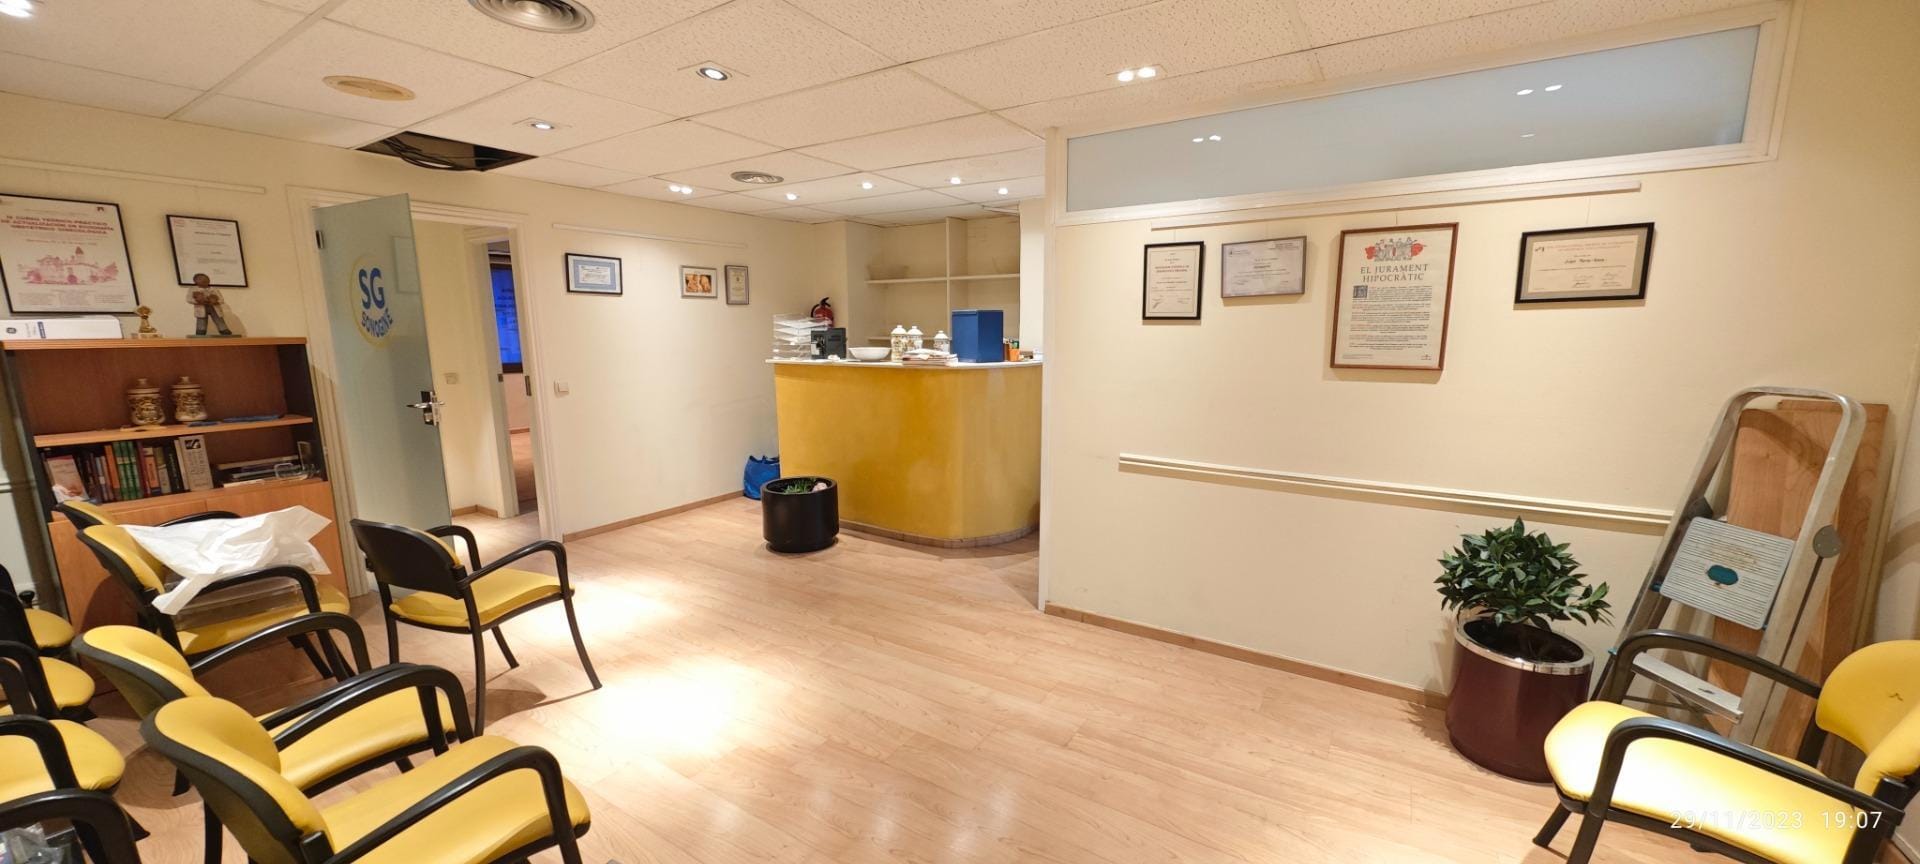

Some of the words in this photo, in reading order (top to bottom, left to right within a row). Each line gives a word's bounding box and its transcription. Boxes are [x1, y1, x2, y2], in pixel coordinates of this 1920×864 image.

[1360, 266, 1372, 275] EL
[1375, 264, 1429, 274] JURAMENT
[1362, 273, 1425, 283] HIPOCRÀTIC
[358, 267, 385, 310] SG
[361, 307, 393, 338] SONOGINE
